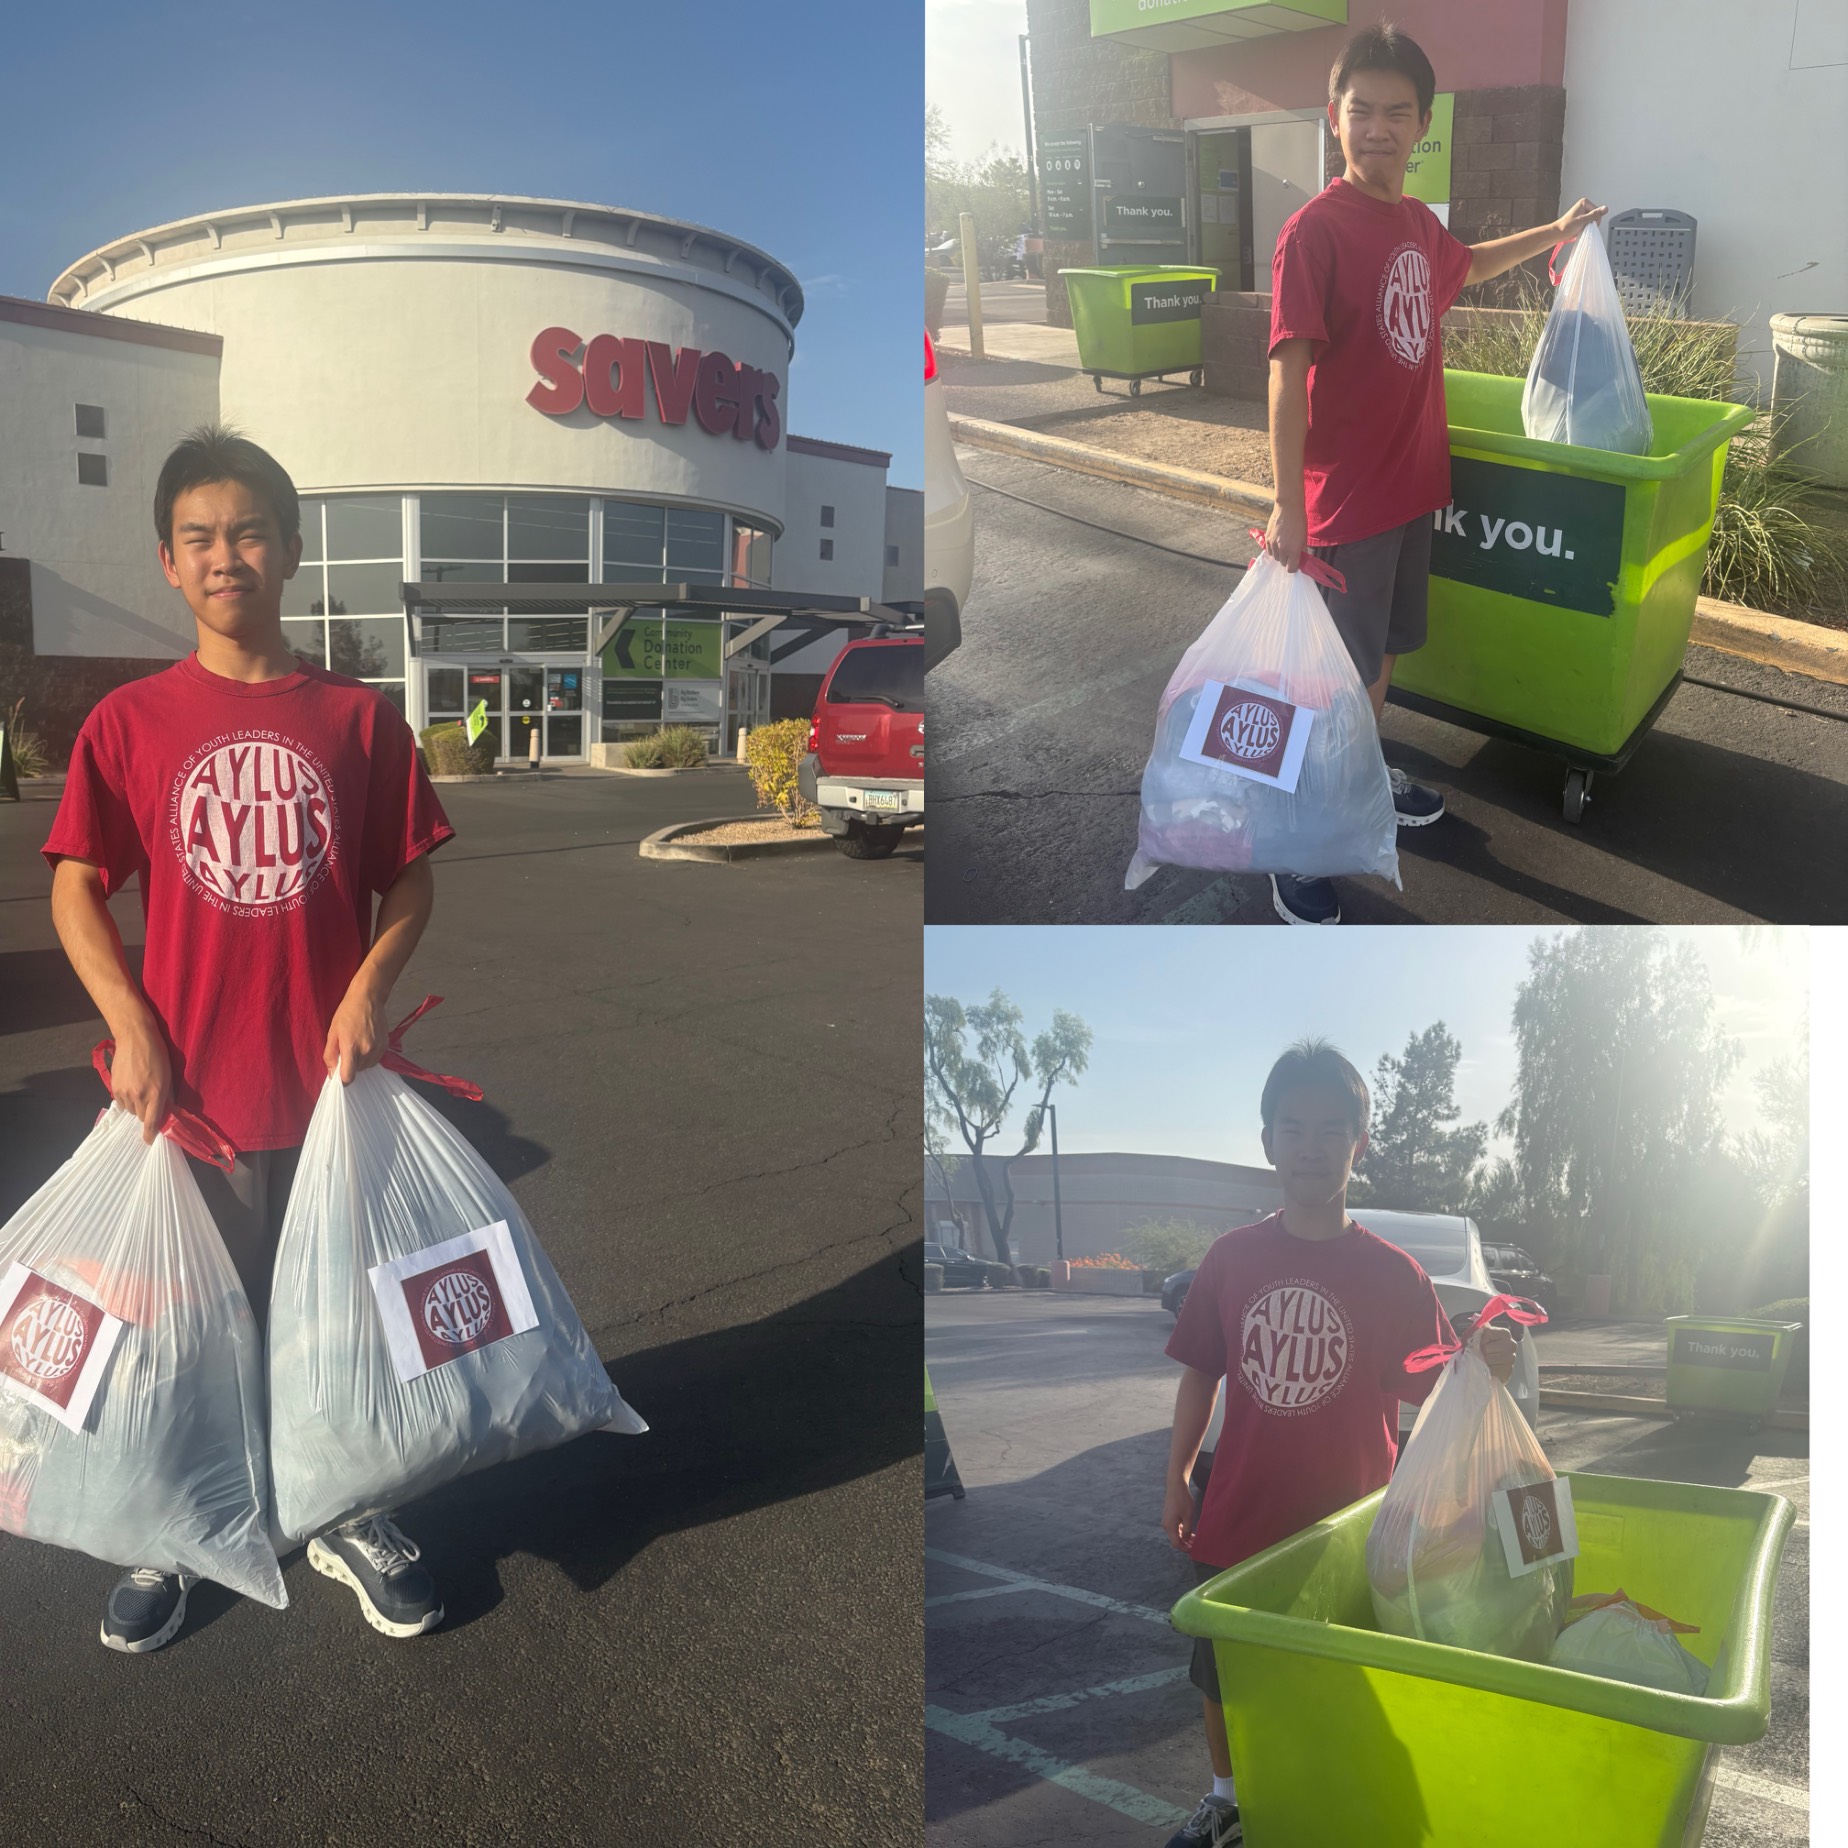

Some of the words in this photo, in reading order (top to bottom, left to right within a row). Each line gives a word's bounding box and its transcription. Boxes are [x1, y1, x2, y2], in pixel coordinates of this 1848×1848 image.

[1116, 206, 1149, 216] Thank
[1150, 207, 1173, 218] you.
[1144, 294, 1181, 310] Thank
[1479, 513, 1575, 561] you.
[643, 639, 703, 655] Donation
[643, 655, 691, 671] Center
[1231, 703, 1278, 727] AYLUS
[1221, 715, 1279, 748] AYLUS
[169, 770, 187, 827] ALLIANCE
[183, 754, 196, 770] OF
[195, 733, 230, 756] YOUTH
[232, 729, 280, 742] LEADERS
[282, 735, 294, 747] IN
[295, 741, 314, 759] THE
[190, 745, 320, 802] AYLUS
[186, 795, 328, 867] AYLUS
[170, 827, 186, 863] STATES
[202, 890, 219, 908] THE
[219, 901, 231, 913] IN
[232, 905, 280, 918] LEADERS
[280, 890, 311, 913] OUTH
[427, 1274, 479, 1305] AYLUS
[28, 1300, 82, 1338] AYLUS
[430, 1285, 490, 1331] AYLUS
[1248, 1292, 1258, 1304] OF
[1258, 1279, 1284, 1295] YOUTH
[1285, 1277, 1320, 1290] LEADERS
[1319, 1286, 1329, 1295] IN
[1327, 1292, 1341, 1306] THE
[1338, 1305, 1354, 1334] UNITED
[1250, 1290, 1341, 1336] AYLUS
[13, 1314, 82, 1367] AYLUS
[1243, 1323, 1345, 1384] AYLUS
[1687, 1341, 1727, 1356] Thank
[1730, 1346, 1760, 1359] you.
[1263, 1405, 1296, 1417] LEADERS
[1296, 1402, 1321, 1417] YOUTH
[1321, 1395, 1331, 1407] OF
